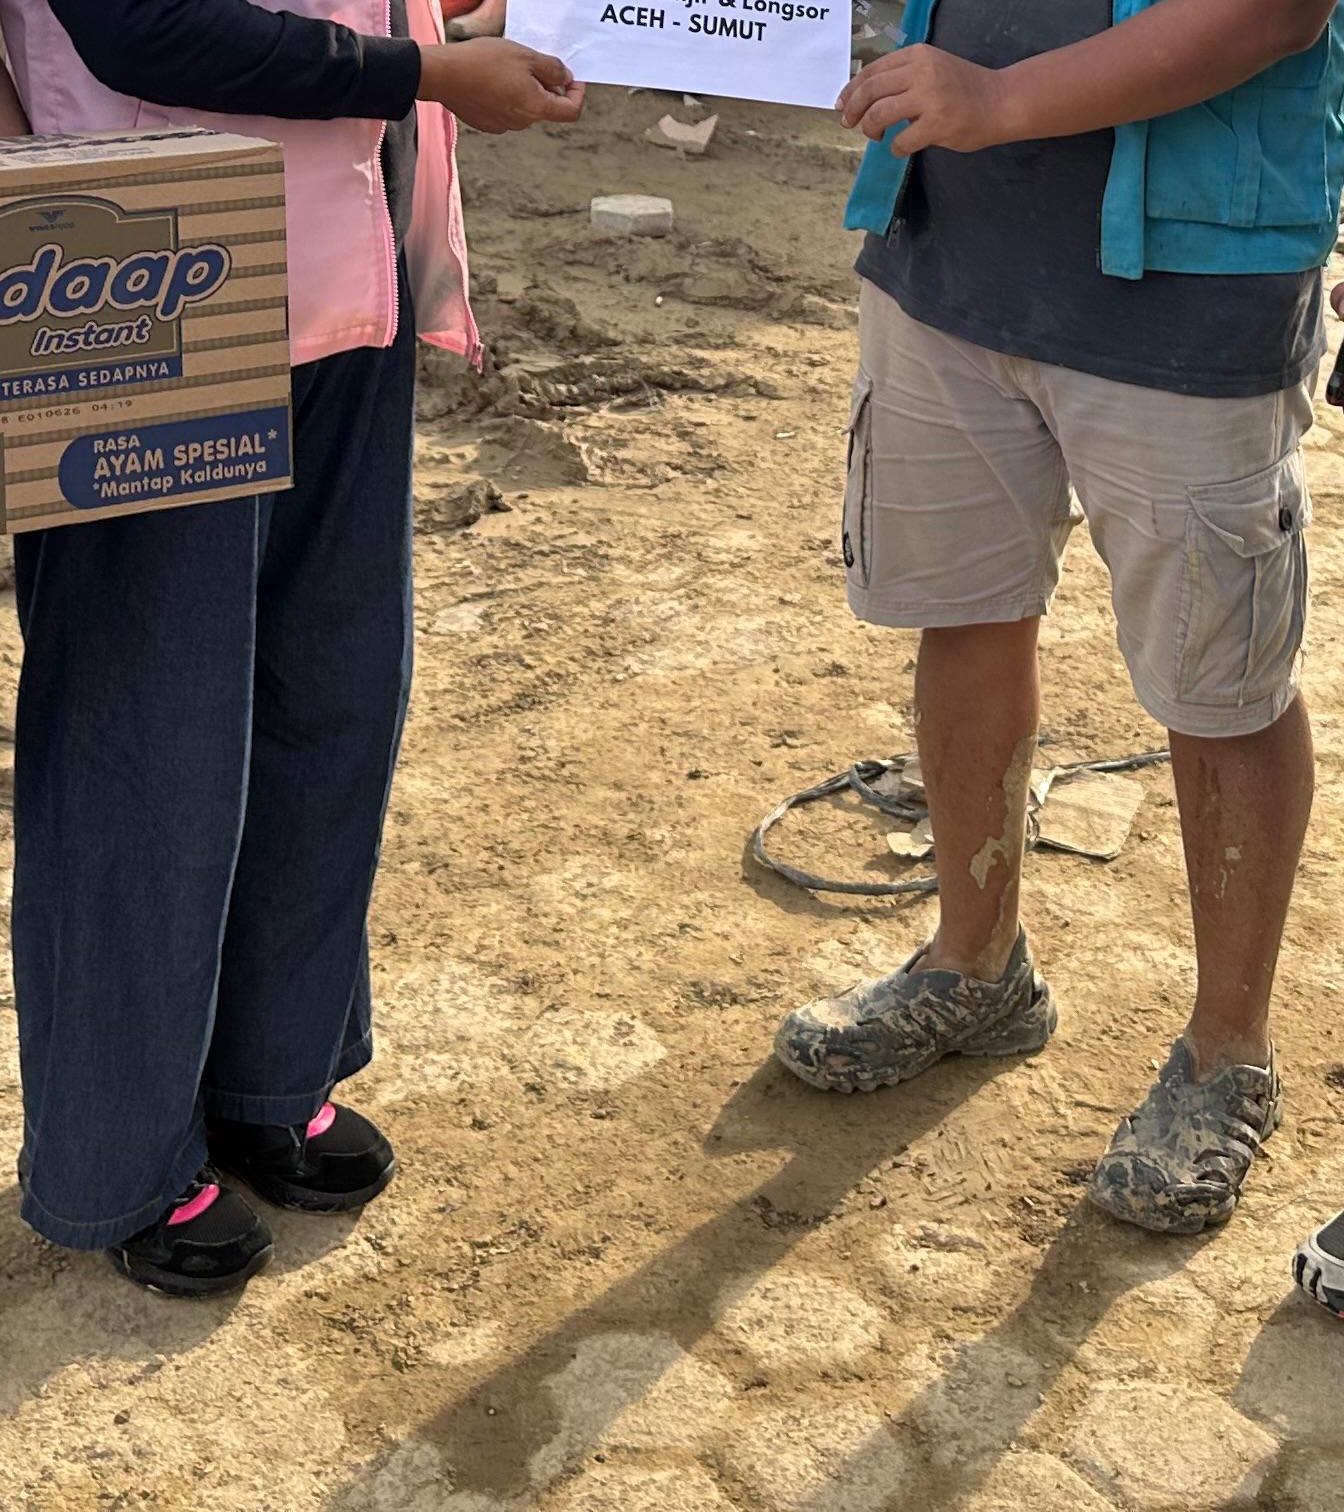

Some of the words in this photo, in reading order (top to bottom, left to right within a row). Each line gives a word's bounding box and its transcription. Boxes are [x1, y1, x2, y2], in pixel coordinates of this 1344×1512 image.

[600, 3, 665, 29] ACEH
[688, 14, 767, 41] SUMUT
[32, 315, 151, 356] Instant
[2, 374, 69, 397] TERASA
[78, 361, 170, 387] SEDAPNYA
[92, 399, 133, 413] 04:19
[93, 435, 141, 453] RASA
[93, 450, 165, 480] AYAM
[180, 459, 267, 486] Kaldunya
